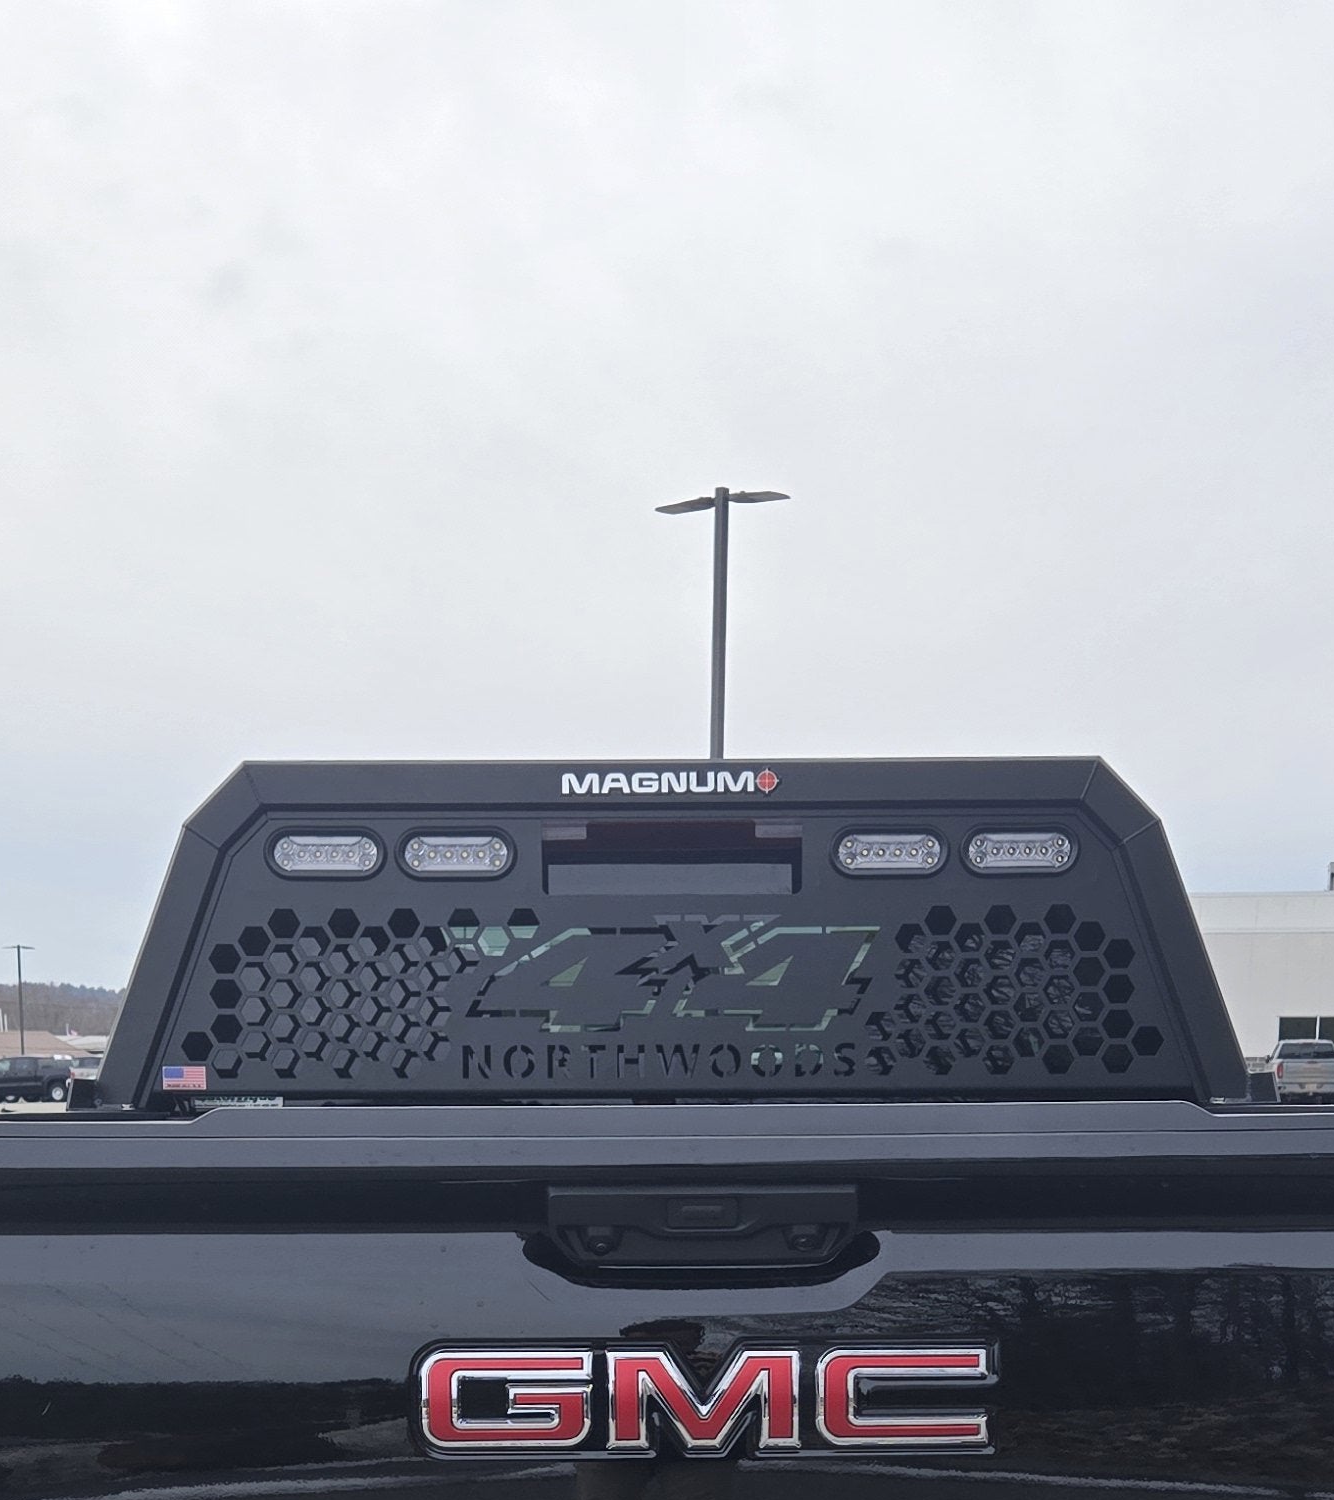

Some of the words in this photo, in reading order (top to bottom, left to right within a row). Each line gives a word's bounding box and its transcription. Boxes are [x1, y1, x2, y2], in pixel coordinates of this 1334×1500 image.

[561, 771, 755, 794] MAGNUM
[461, 1042, 857, 1080] NORTHWOODS
[419, 1347, 990, 1450] GMC
